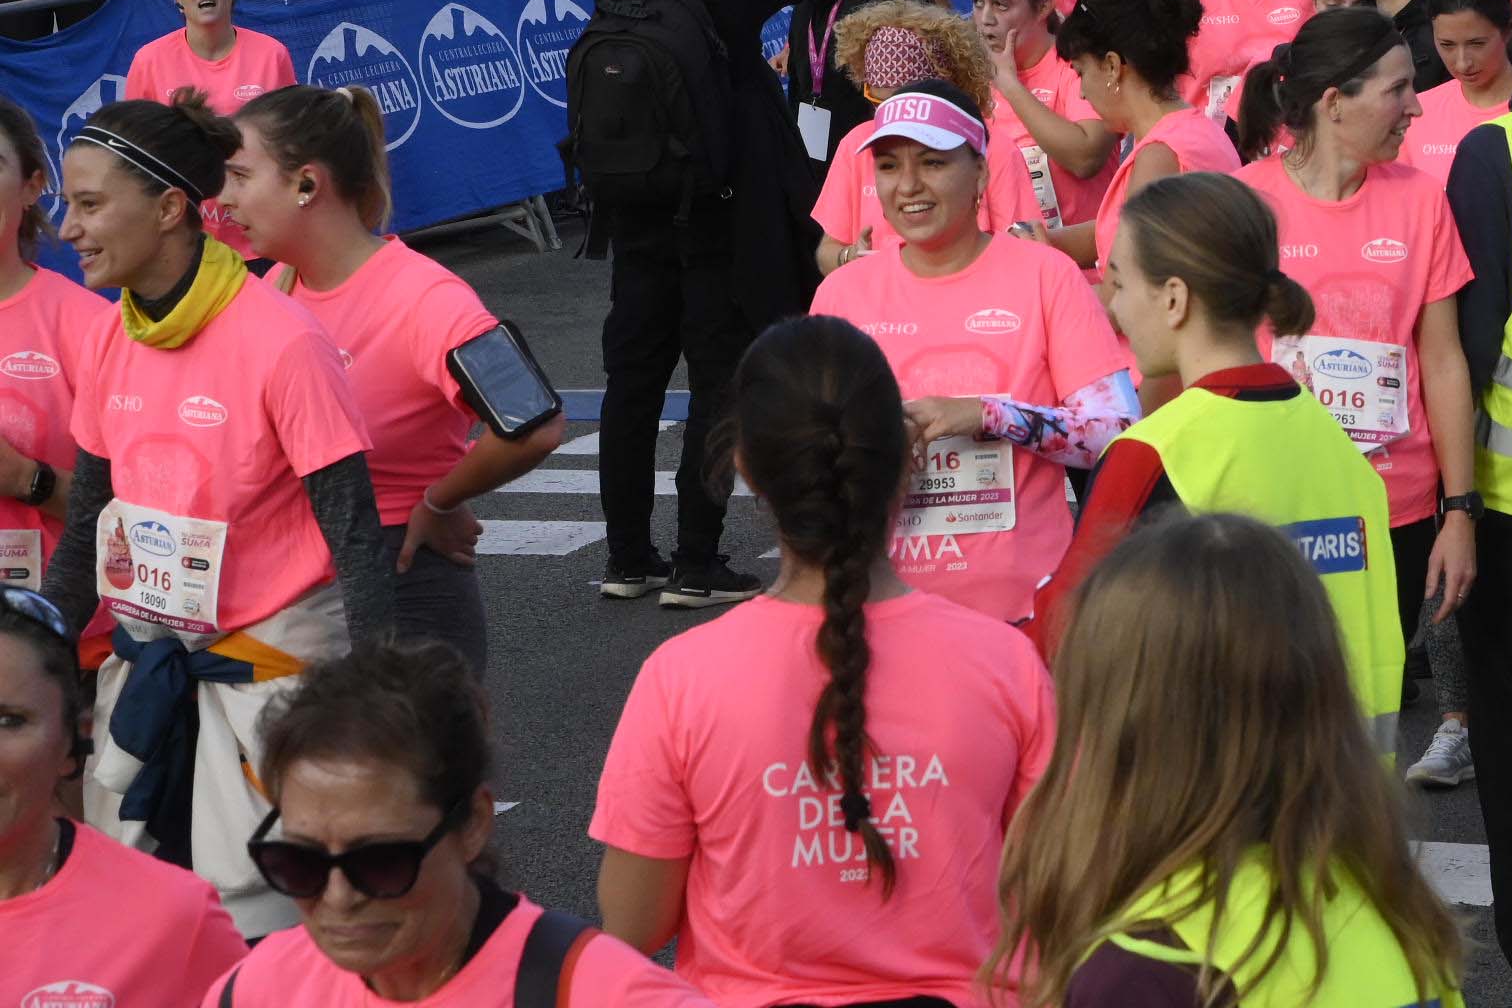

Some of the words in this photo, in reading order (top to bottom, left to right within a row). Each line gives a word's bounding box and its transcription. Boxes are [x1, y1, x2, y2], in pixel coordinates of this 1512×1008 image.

[438, 46, 471, 63] CENTRAL
[328, 67, 363, 85] CENTRAL
[429, 54, 521, 102] ASTURIANA
[883, 99, 932, 124] OTSO
[1281, 244, 1318, 258] SHO
[1319, 359, 1368, 374] ASTURIANA
[109, 394, 143, 412] SHO
[1320, 388, 1365, 408] 016
[1332, 414, 1356, 424] 263
[1350, 432, 1376, 440] MUJER
[930, 452, 960, 472] 16
[919, 477, 956, 491] 29953
[936, 494, 947, 504] LA
[948, 494, 978, 504] MUJER
[958, 511, 1004, 523] Santander
[181, 538, 211, 548] SUMA
[1298, 532, 1361, 562] TARIS
[138, 564, 172, 591] 016
[140, 592, 166, 610] 18090
